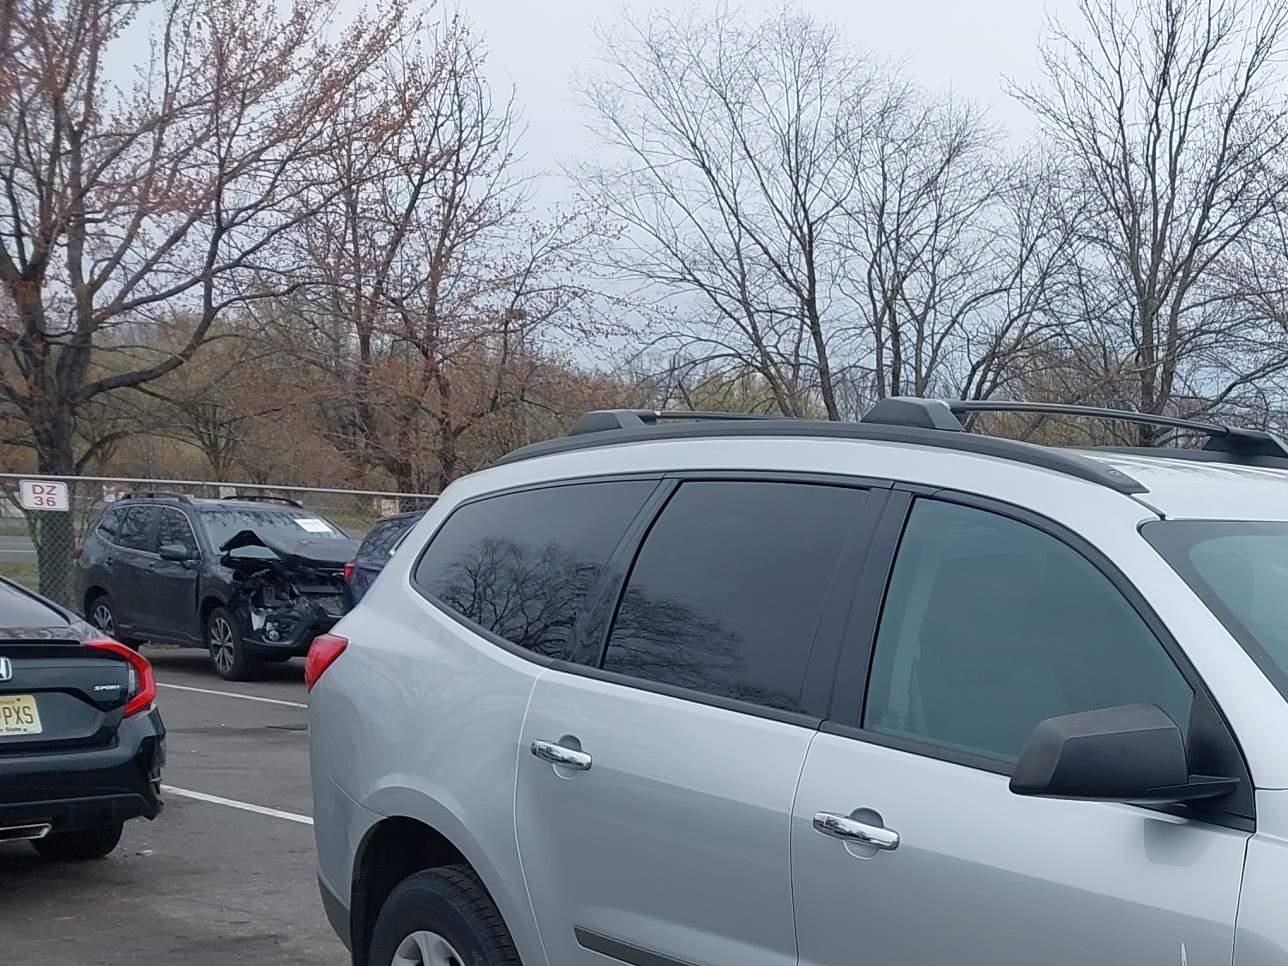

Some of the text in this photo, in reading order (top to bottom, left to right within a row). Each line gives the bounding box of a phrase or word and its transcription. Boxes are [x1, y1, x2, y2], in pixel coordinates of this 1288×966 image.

[32, 484, 57, 496] DZ
[34, 496, 56, 507] 36
[0, 706, 34, 726] PXS
